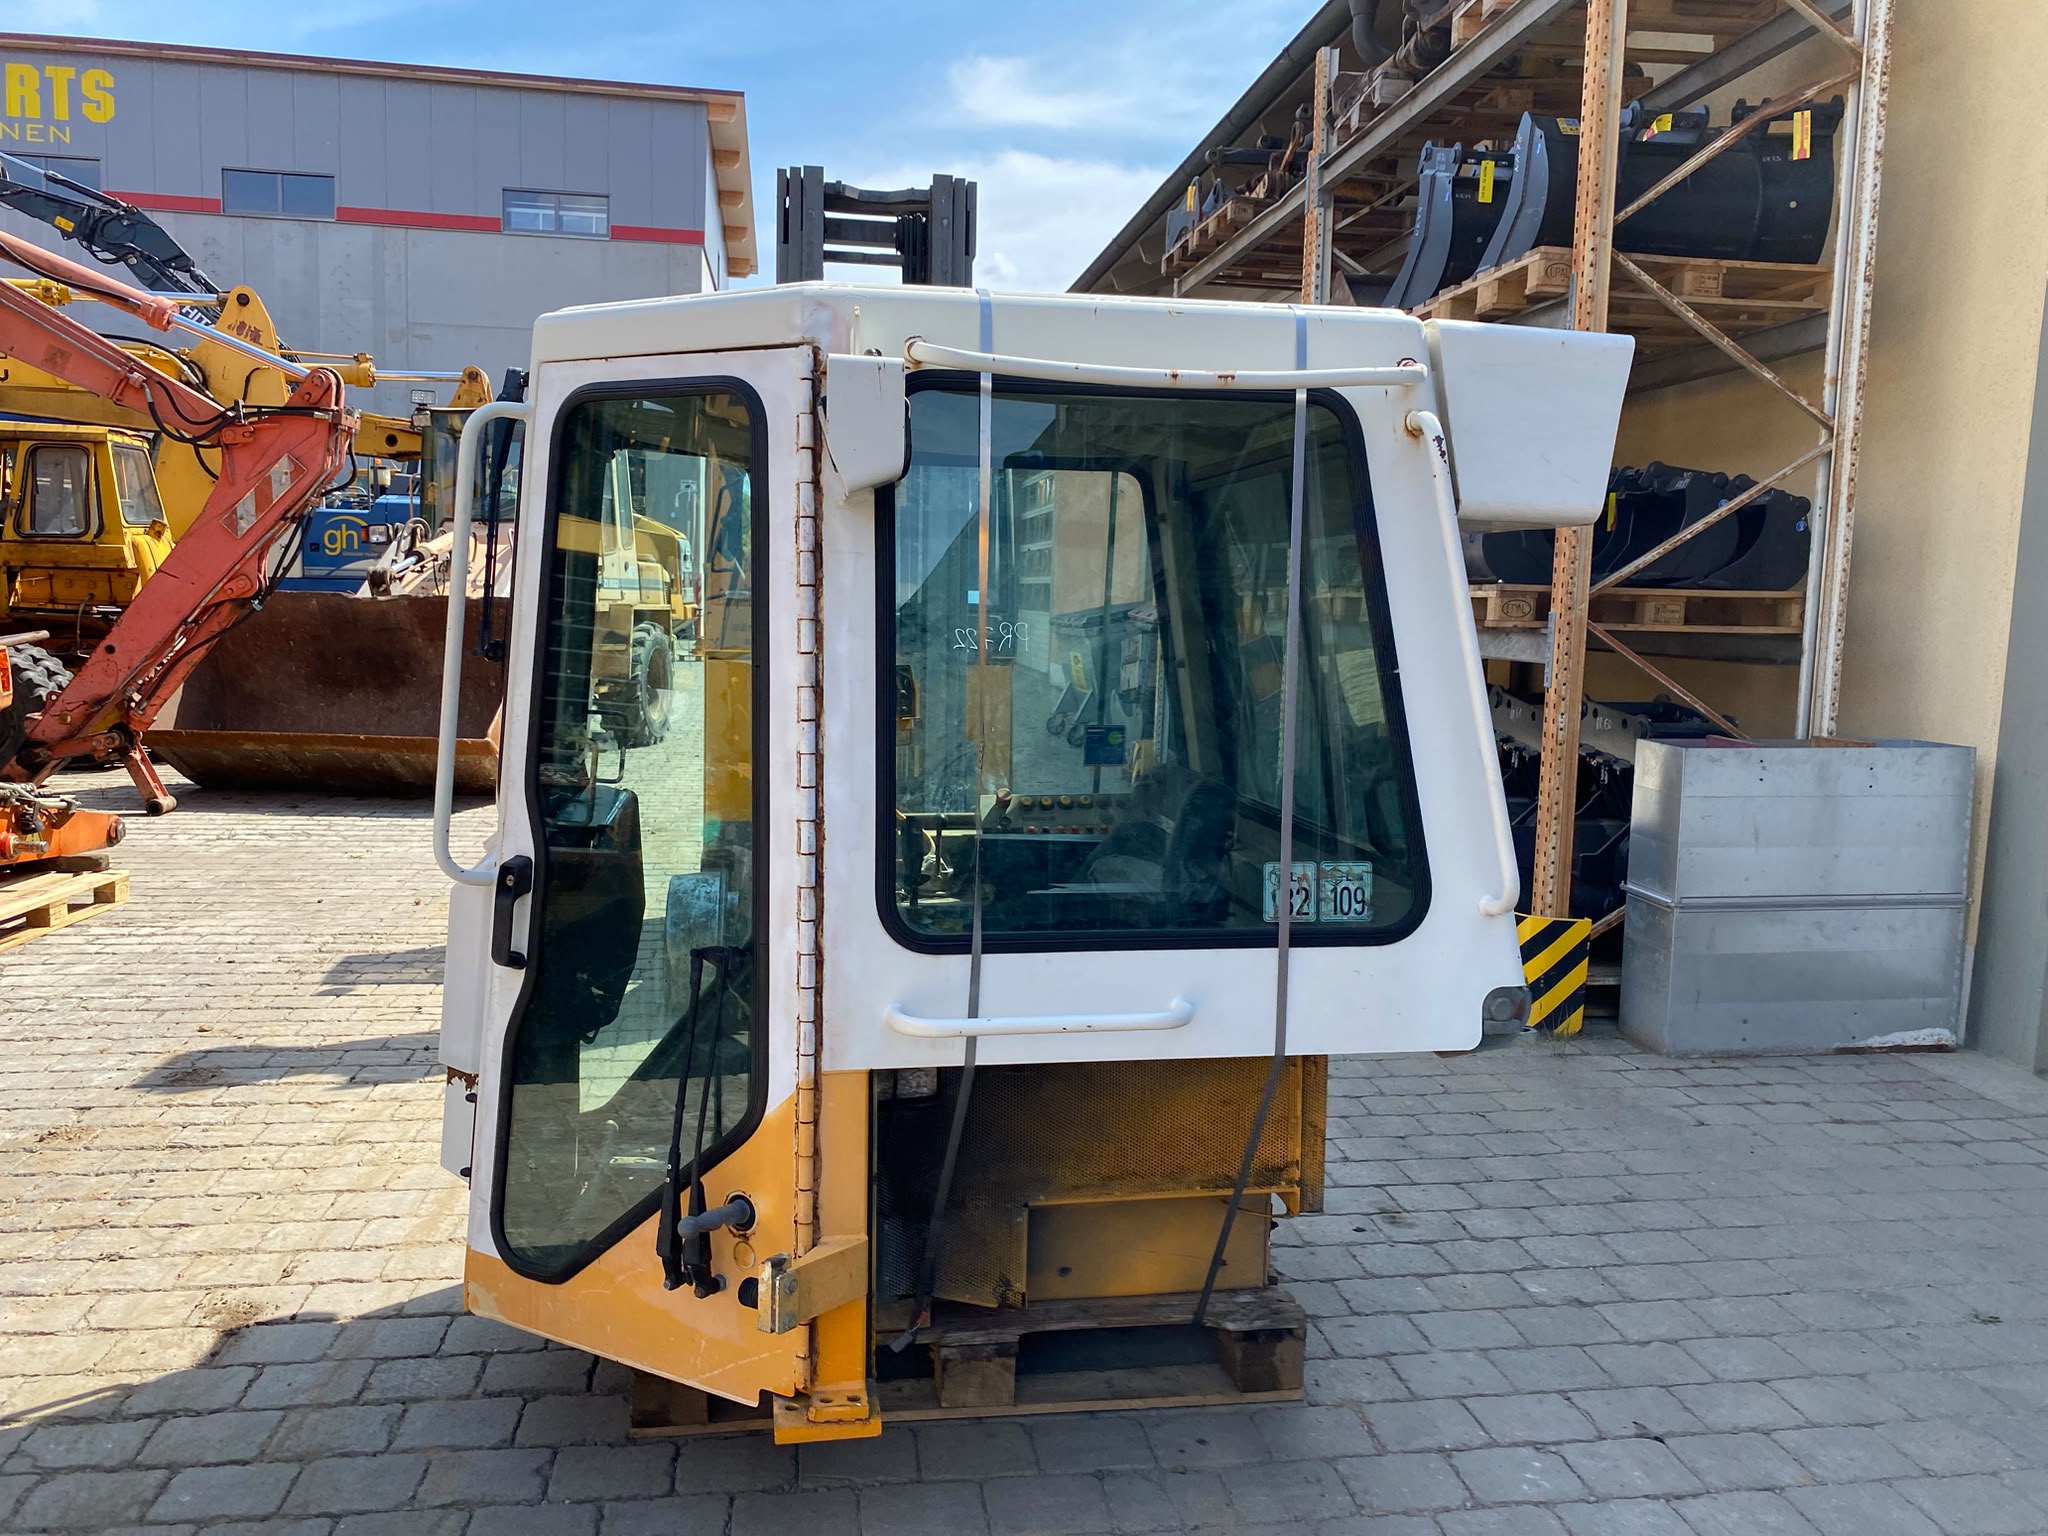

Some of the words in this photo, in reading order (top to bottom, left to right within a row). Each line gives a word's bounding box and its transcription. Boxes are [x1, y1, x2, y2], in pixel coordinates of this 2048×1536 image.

[5, 63, 115, 123] RTS
[0, 122, 71, 144] NEN
[323, 523, 359, 556] gh
[1330, 886, 1366, 916] 109
